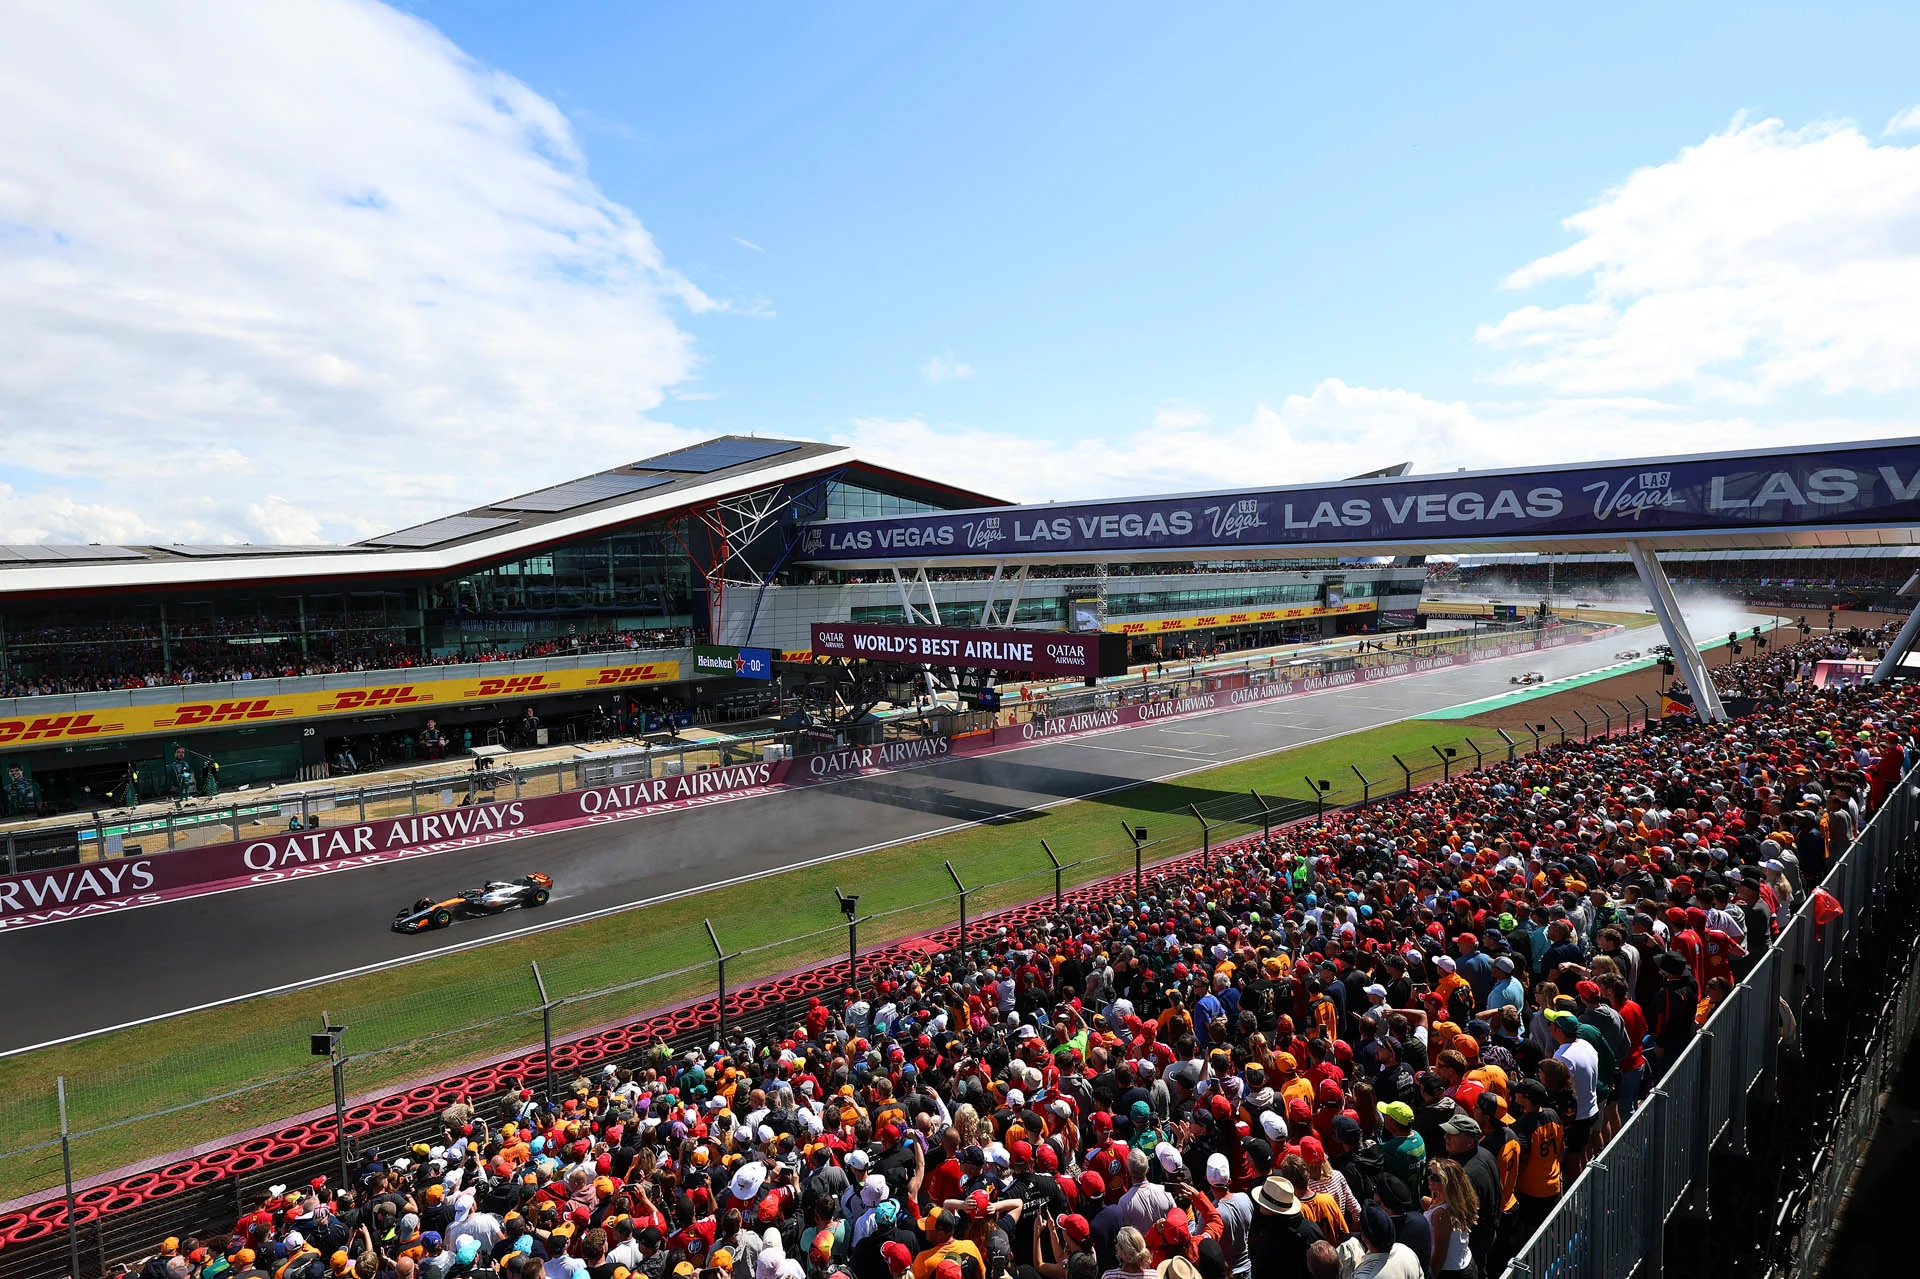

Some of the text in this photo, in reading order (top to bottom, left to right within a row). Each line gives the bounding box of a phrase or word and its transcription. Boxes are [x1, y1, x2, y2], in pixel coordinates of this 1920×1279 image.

[1641, 473, 1668, 488] LAS
[1710, 468, 1859, 510] LAS
[1239, 500, 1257, 512] LAS
[1284, 487, 1564, 530] LAS VEGAS
[1582, 476, 1686, 521] Vegas
[1014, 511, 1193, 542] LAS VEGAS
[1204, 505, 1267, 539] Vegas
[830, 526, 954, 550] LAS VEGAS
[962, 519, 1006, 550] Vegas
[1197, 617, 1216, 626] DHL
[1230, 614, 1247, 623] DHL
[1287, 609, 1302, 617] DHL
[1122, 623, 1145, 633] DHL
[1161, 620, 1182, 630] DHL
[819, 632, 844, 643] QATAR
[853, 635, 1034, 662] WORLD'S BEST AIRLINE
[1047, 644, 1085, 657] QATAR
[697, 655, 732, 669] Heineken
[1055, 657, 1085, 666] AIRWAYS
[1364, 663, 1408, 680] QATAR AIRWAYS
[1415, 658, 1433, 671] QATAR
[599, 665, 657, 684] DHL
[1304, 671, 1355, 691] QATAR AIRWAYS
[478, 675, 548, 696] DHL
[1231, 681, 1293, 704] QATAR AIRWAYS
[335, 686, 420, 709] DHL
[1138, 701, 1173, 720] QATAR
[1175, 694, 1215, 713] AIRWAYS
[174, 700, 276, 725] DHL
[1069, 709, 1119, 730] AIRWAYS
[0, 714, 102, 743] DHL
[303, 728, 315, 737] 20
[810, 748, 873, 776] QATAR
[878, 736, 948, 764] AIRWAYS
[580, 780, 669, 814] QATAR
[674, 763, 771, 798] AIRWAYS
[243, 802, 525, 871] QATAR AIRWAYS
[250, 828, 536, 882] QATAR AIRWAYS
